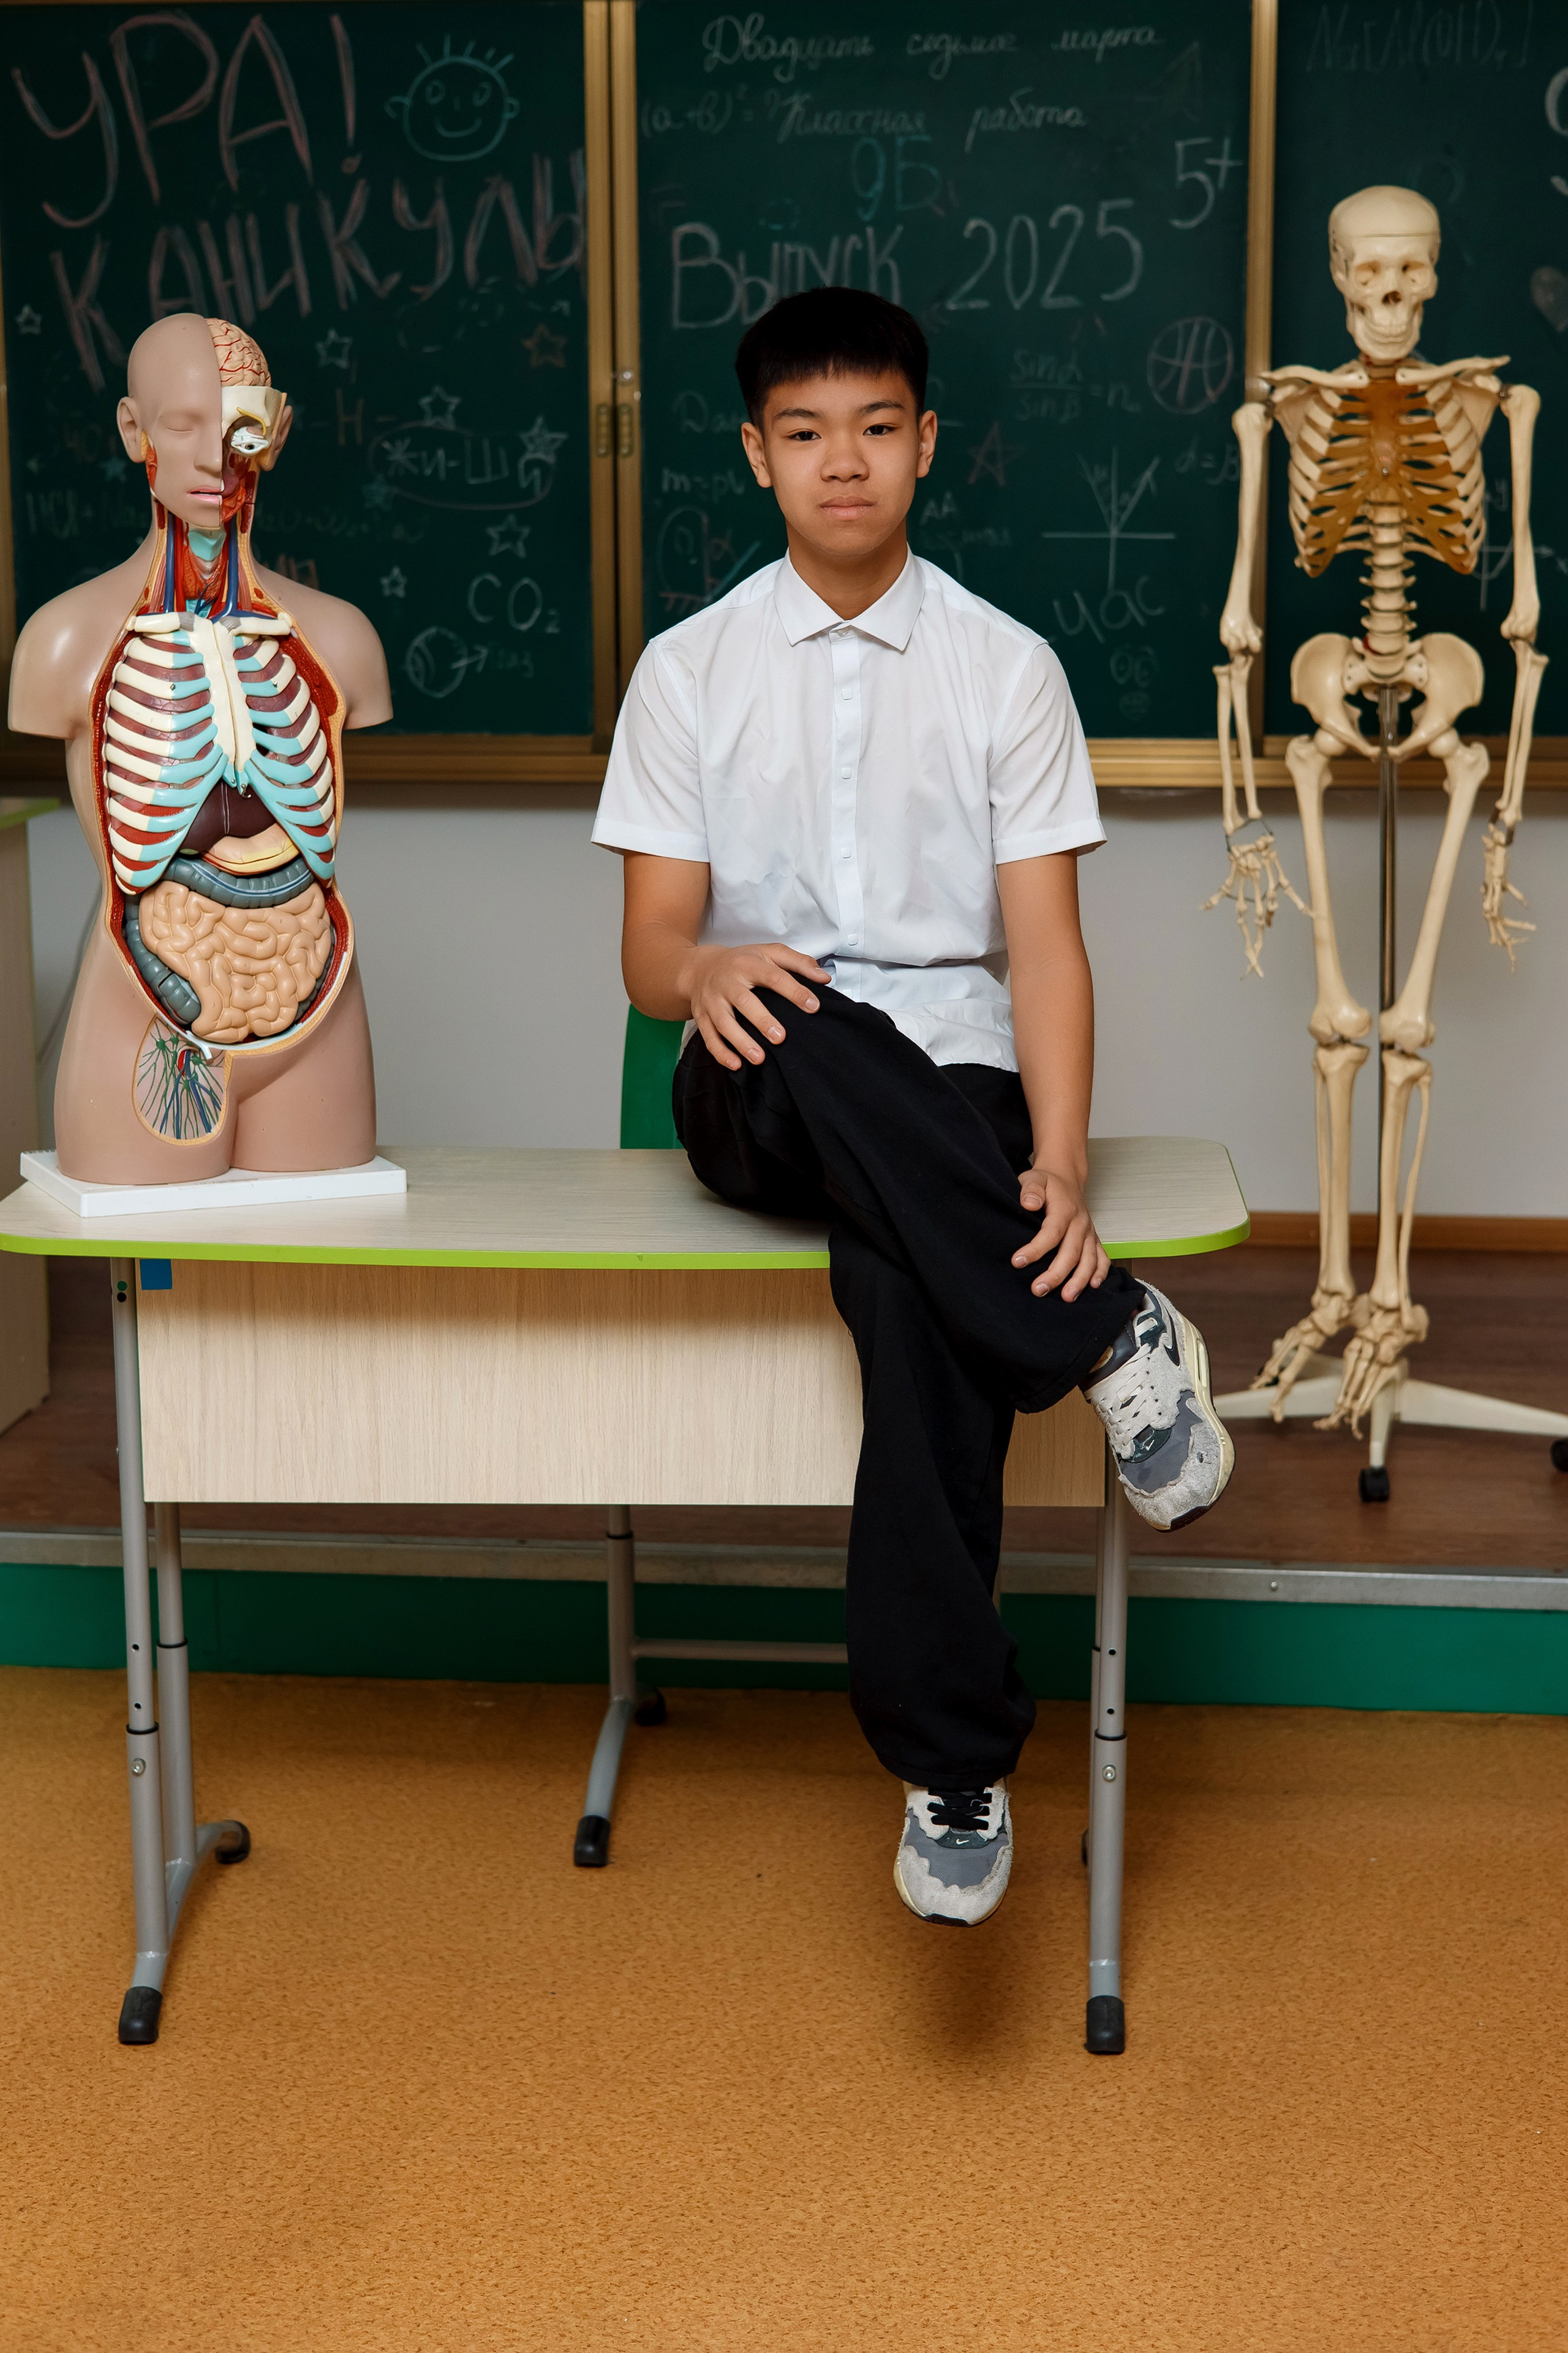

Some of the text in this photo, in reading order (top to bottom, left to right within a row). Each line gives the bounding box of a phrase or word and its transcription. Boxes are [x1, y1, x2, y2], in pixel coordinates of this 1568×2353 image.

[702, 11, 1163, 84] Двадцать седьмое марта
[11, 13, 364, 229] УРА!
[775, 85, 1089, 154] Классная работа
[851, 134, 943, 221] 9Б
[1167, 134, 1243, 230] 5+
[946, 198, 1144, 311] 2025
